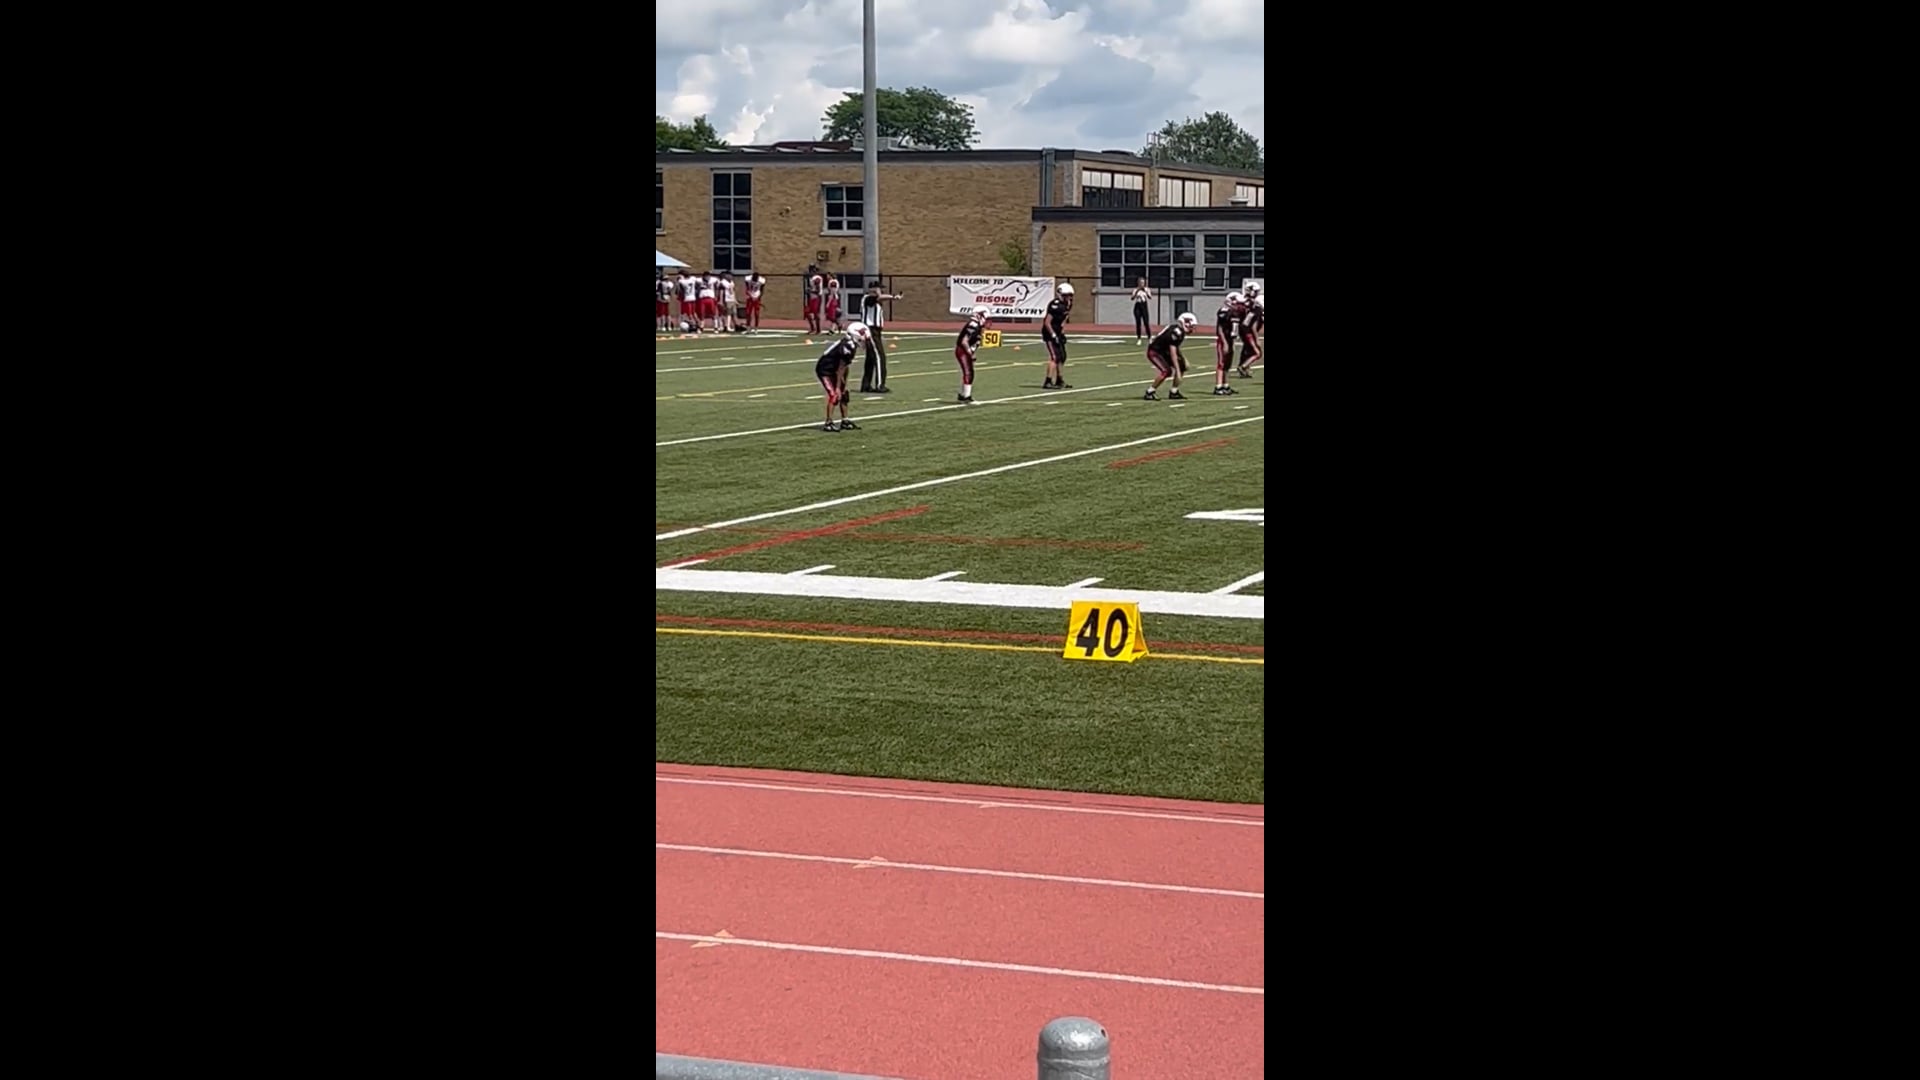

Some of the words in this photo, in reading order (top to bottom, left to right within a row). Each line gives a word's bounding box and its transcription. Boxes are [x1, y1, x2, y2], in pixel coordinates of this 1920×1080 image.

[976, 295, 1016, 303] BISONS
[985, 333, 998, 344] 50
[1075, 607, 1129, 658] 40
